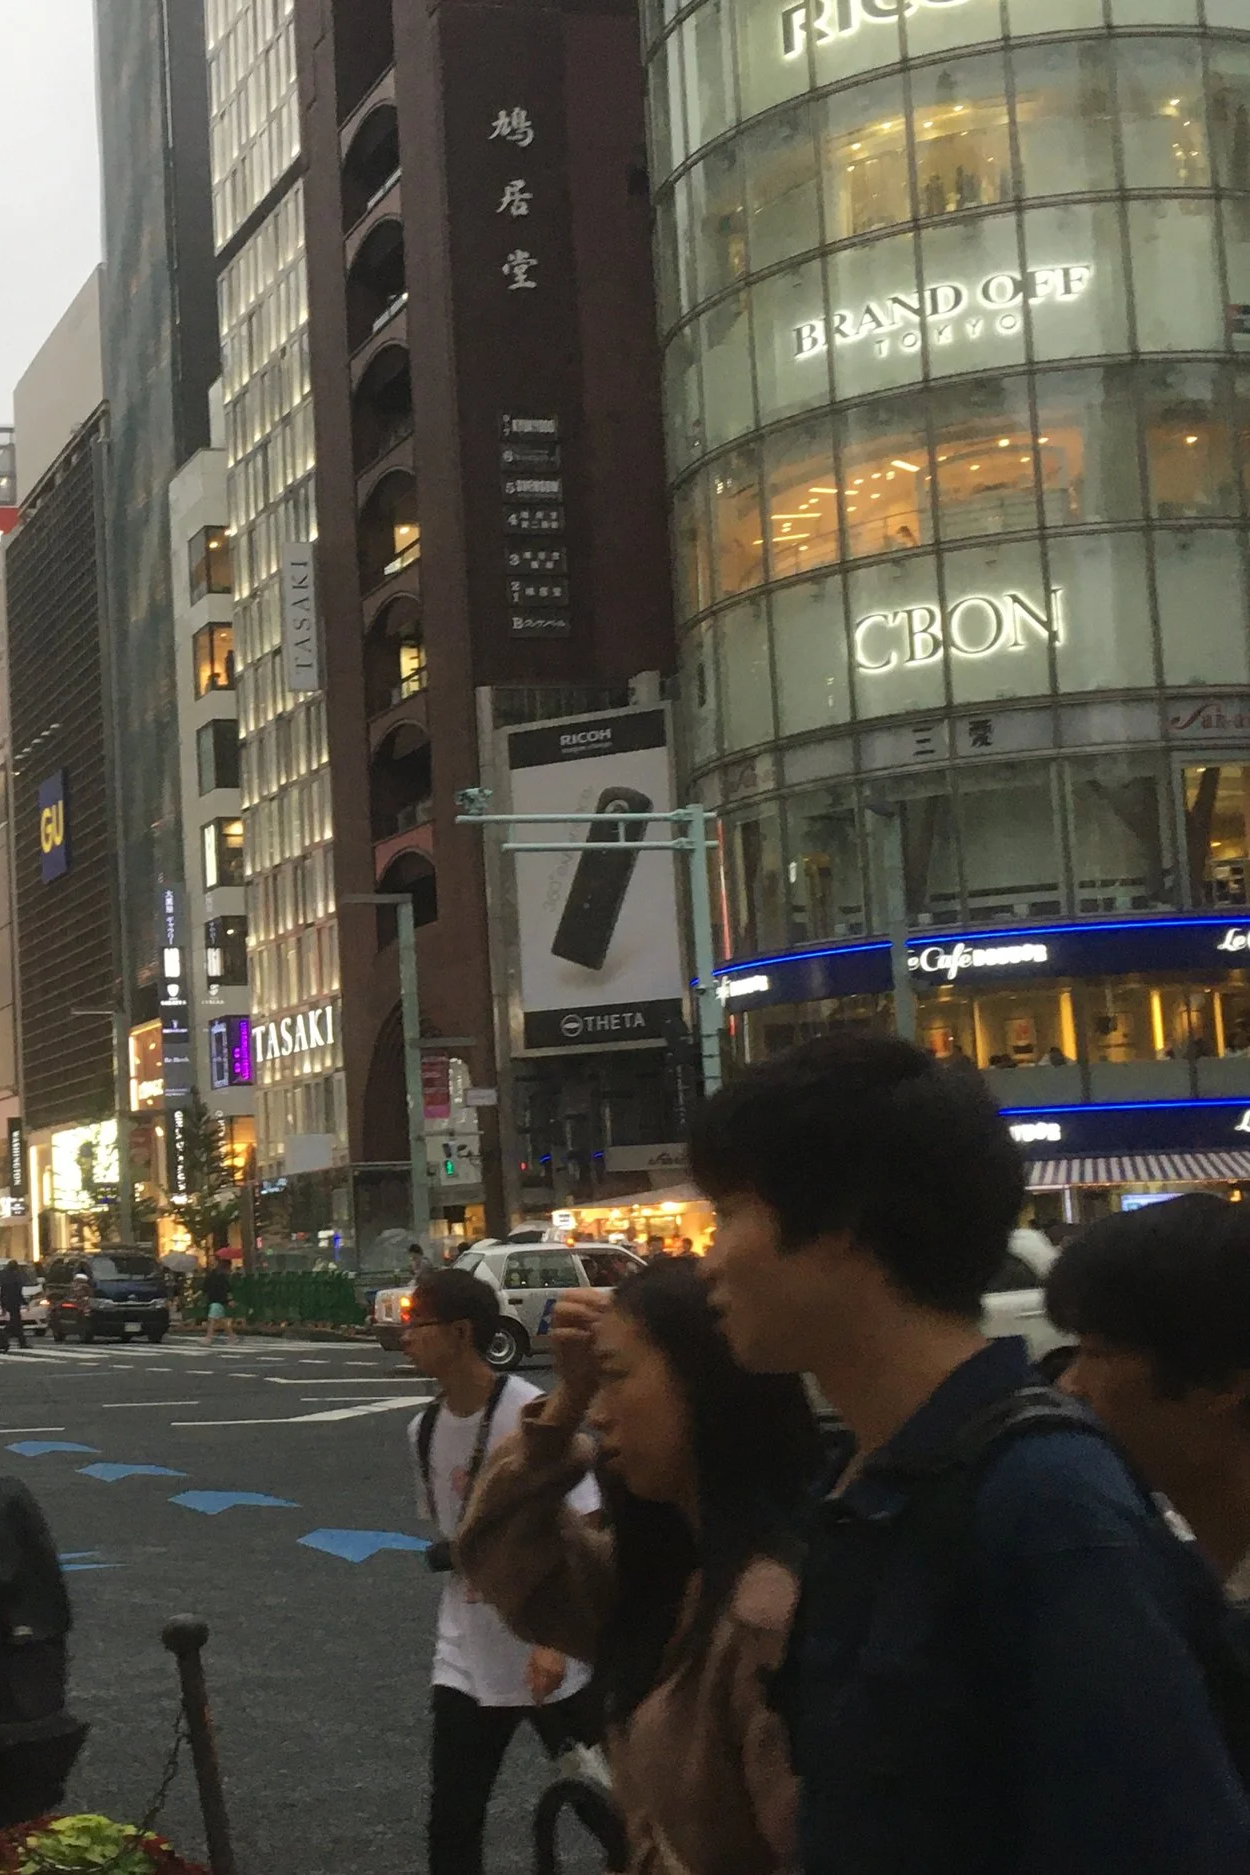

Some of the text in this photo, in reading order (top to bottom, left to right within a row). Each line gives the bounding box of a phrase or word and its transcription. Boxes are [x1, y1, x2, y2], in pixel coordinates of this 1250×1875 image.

[488, 107, 538, 290] 鳩居堂
[793, 265, 1090, 359] BRAND OFF
[874, 312, 1020, 358] TOKYO
[291, 561, 313, 674] TASAKI
[560, 728, 611, 746] RICOH
[912, 718, 995, 757] 三愛
[41, 800, 64, 853] GU
[920, 943, 973, 980] Café
[252, 1006, 334, 1062] TASAKI
[584, 1012, 646, 1033] THETA
[12, 1130, 22, 1186] WASHINGTON
